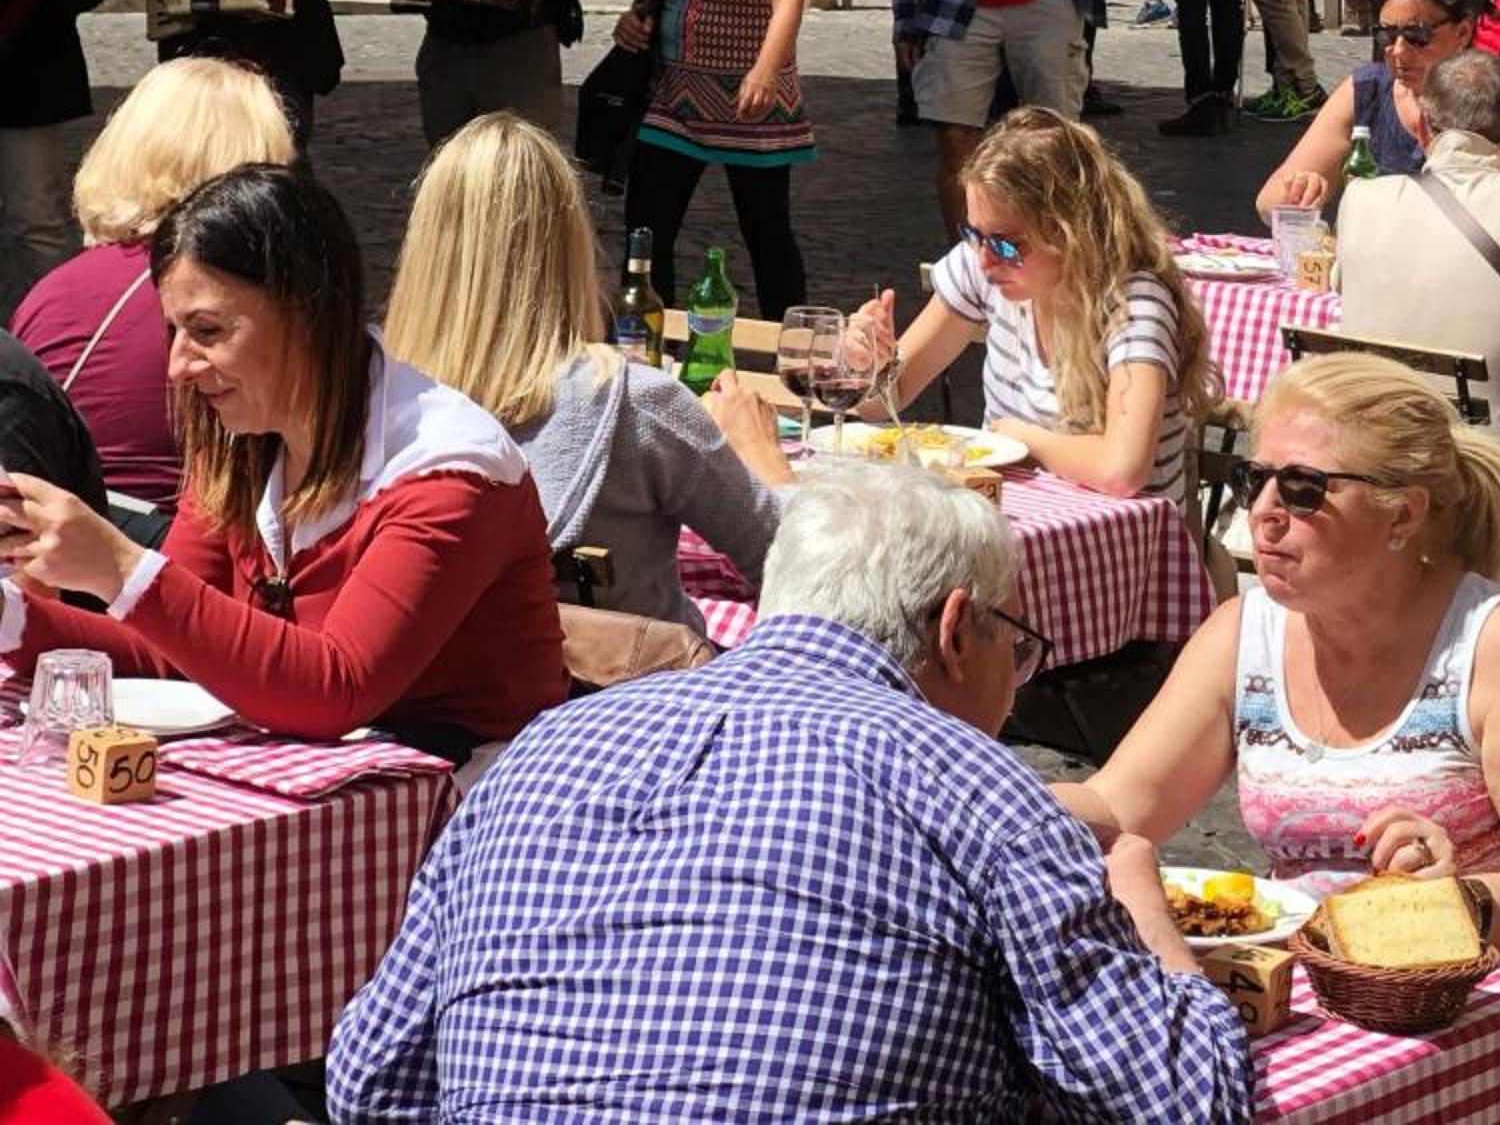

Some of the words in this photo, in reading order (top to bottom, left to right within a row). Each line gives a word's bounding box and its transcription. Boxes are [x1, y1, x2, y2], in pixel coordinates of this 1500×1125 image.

[1303, 261, 1322, 285] 57
[77, 739, 99, 789] 50
[109, 750, 155, 794] 50
